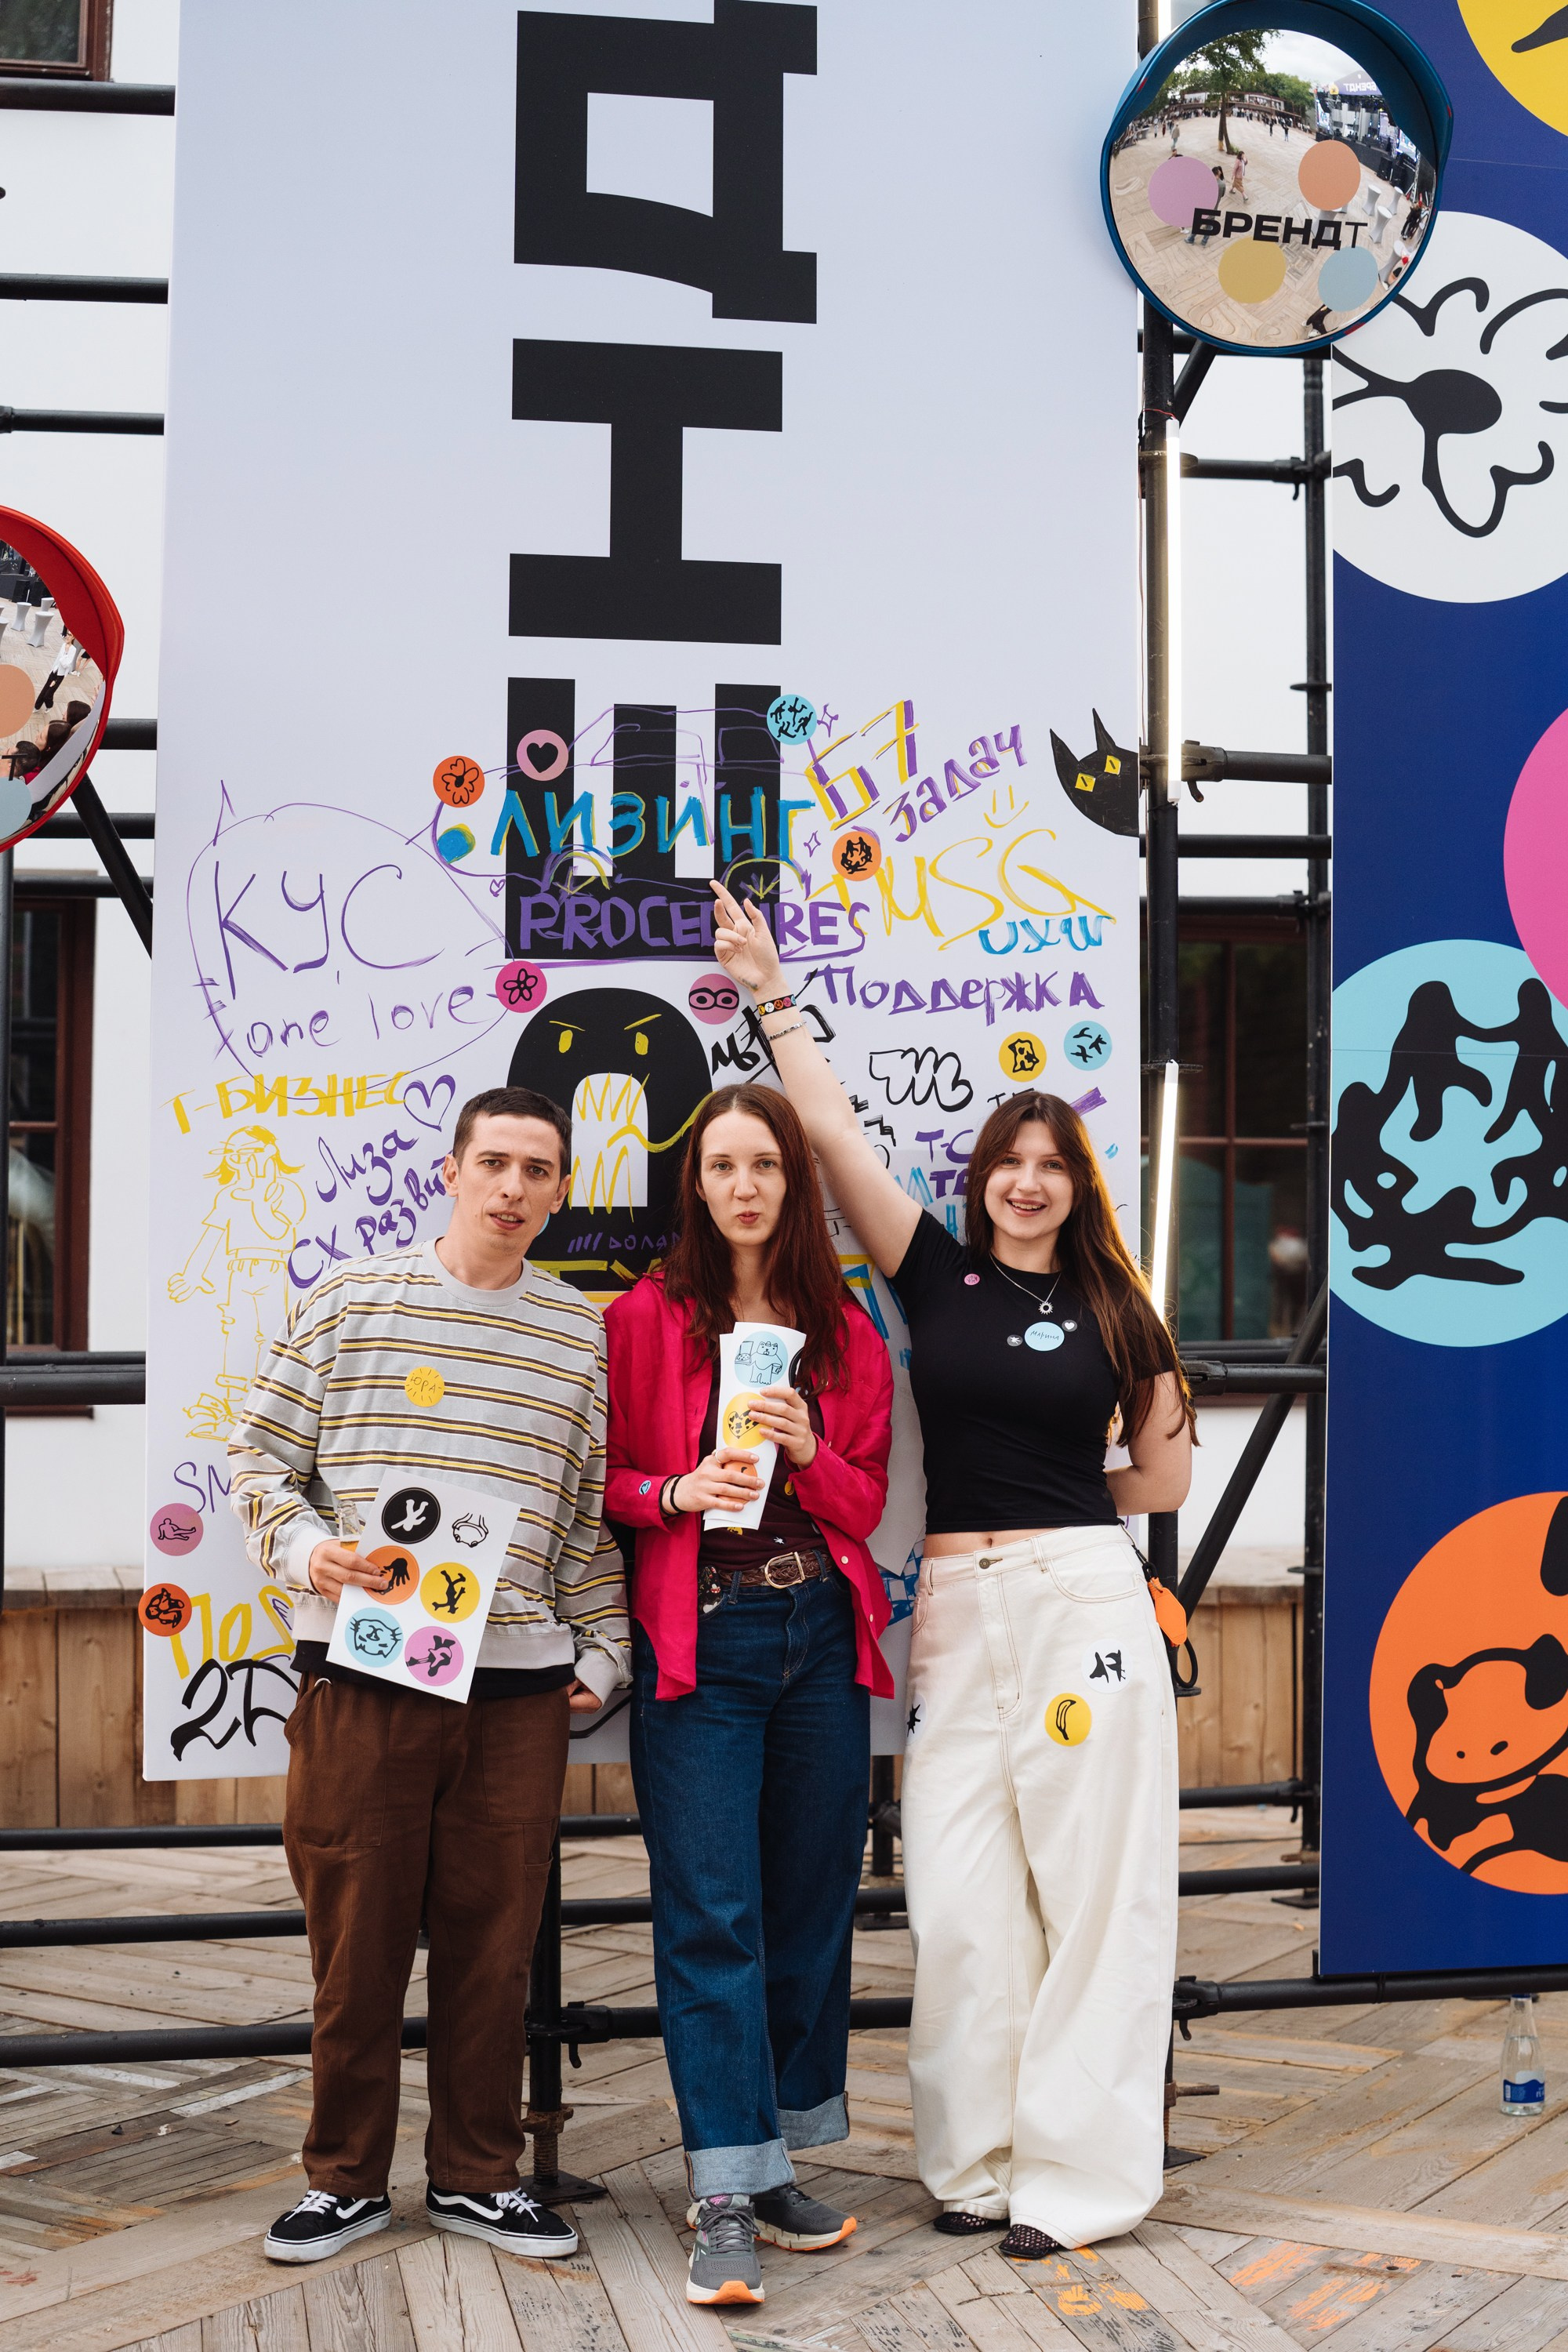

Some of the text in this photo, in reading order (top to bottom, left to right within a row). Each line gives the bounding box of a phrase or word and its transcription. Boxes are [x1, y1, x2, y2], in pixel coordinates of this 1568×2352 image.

[1191, 208, 1368, 251] БРЕНДТ
[491, 786, 816, 862] ЛИЗИНГ
[520, 895, 870, 952] PROCERES
[368, 985, 498, 1040] love
[316, 1129, 419, 1206] Лиза
